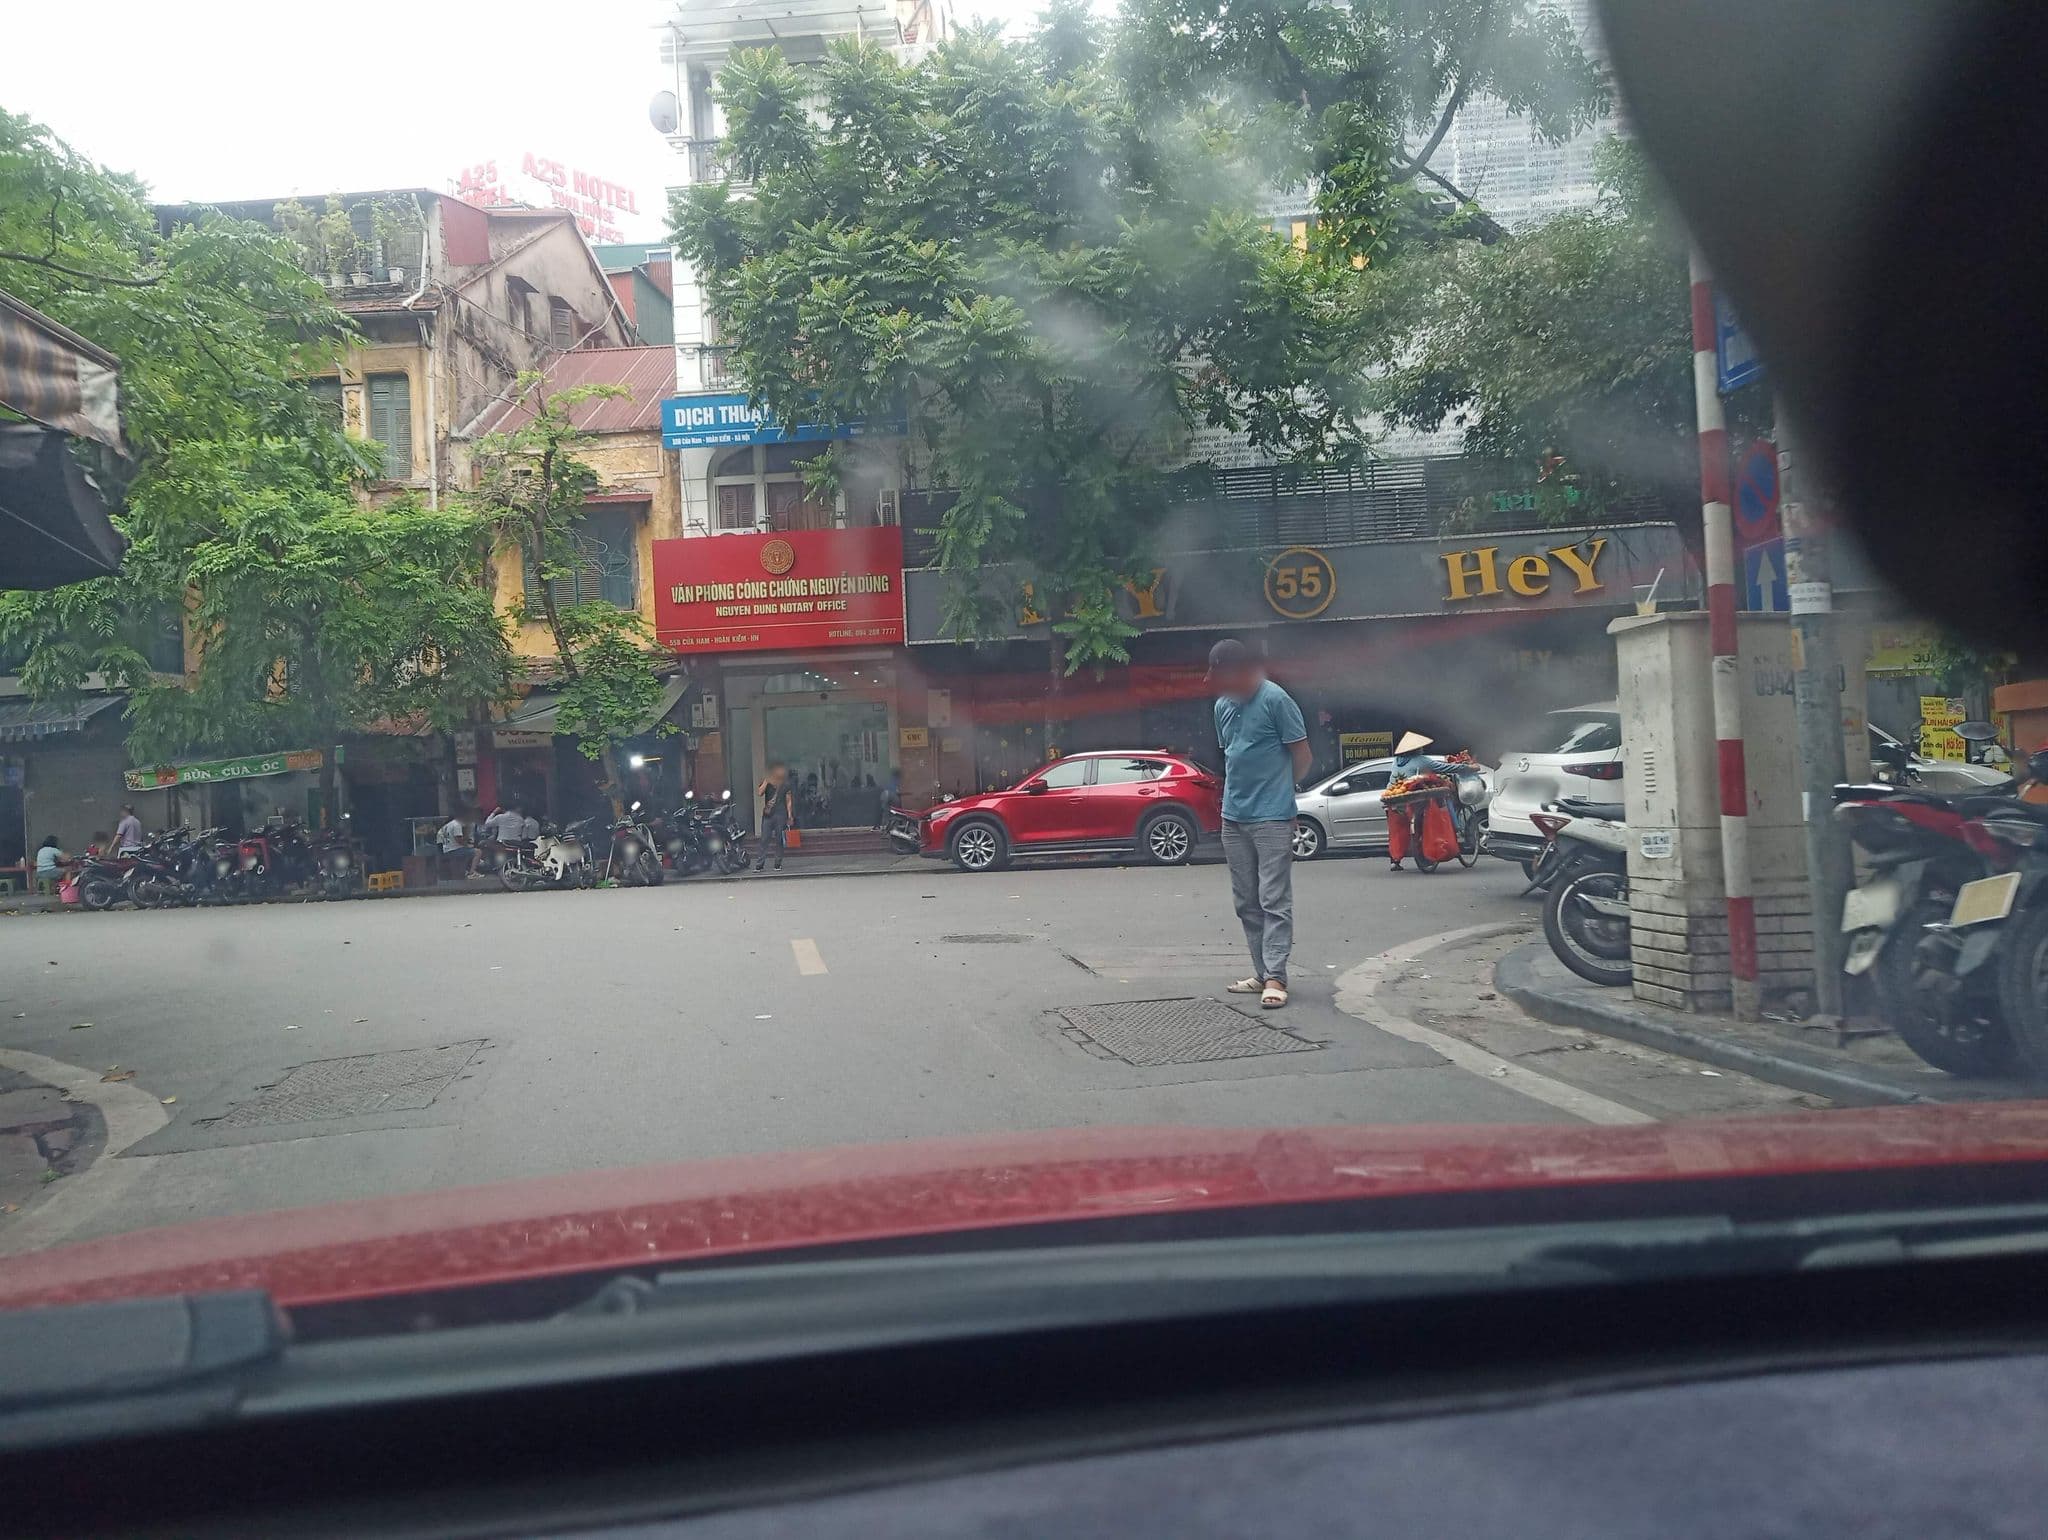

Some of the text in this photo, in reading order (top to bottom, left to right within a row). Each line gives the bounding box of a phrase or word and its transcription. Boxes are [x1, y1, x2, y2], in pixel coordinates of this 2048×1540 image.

[521, 151, 568, 188] A25
[573, 168, 640, 215] HOTEL
[675, 407, 714, 430] DỊCH
[1276, 538, 1608, 602] 55 HeY
[671, 583, 693, 604] VĂN
[696, 580, 734, 602] PHÒNG
[737, 578, 767, 599] CÔNG
[769, 576, 807, 597] CHỨNG
[715, 599, 847, 617] NGUYEN DUNG NOTARY OFFICE
[221, 765, 251, 777] CUA
[262, 758, 280, 771] ỐC
